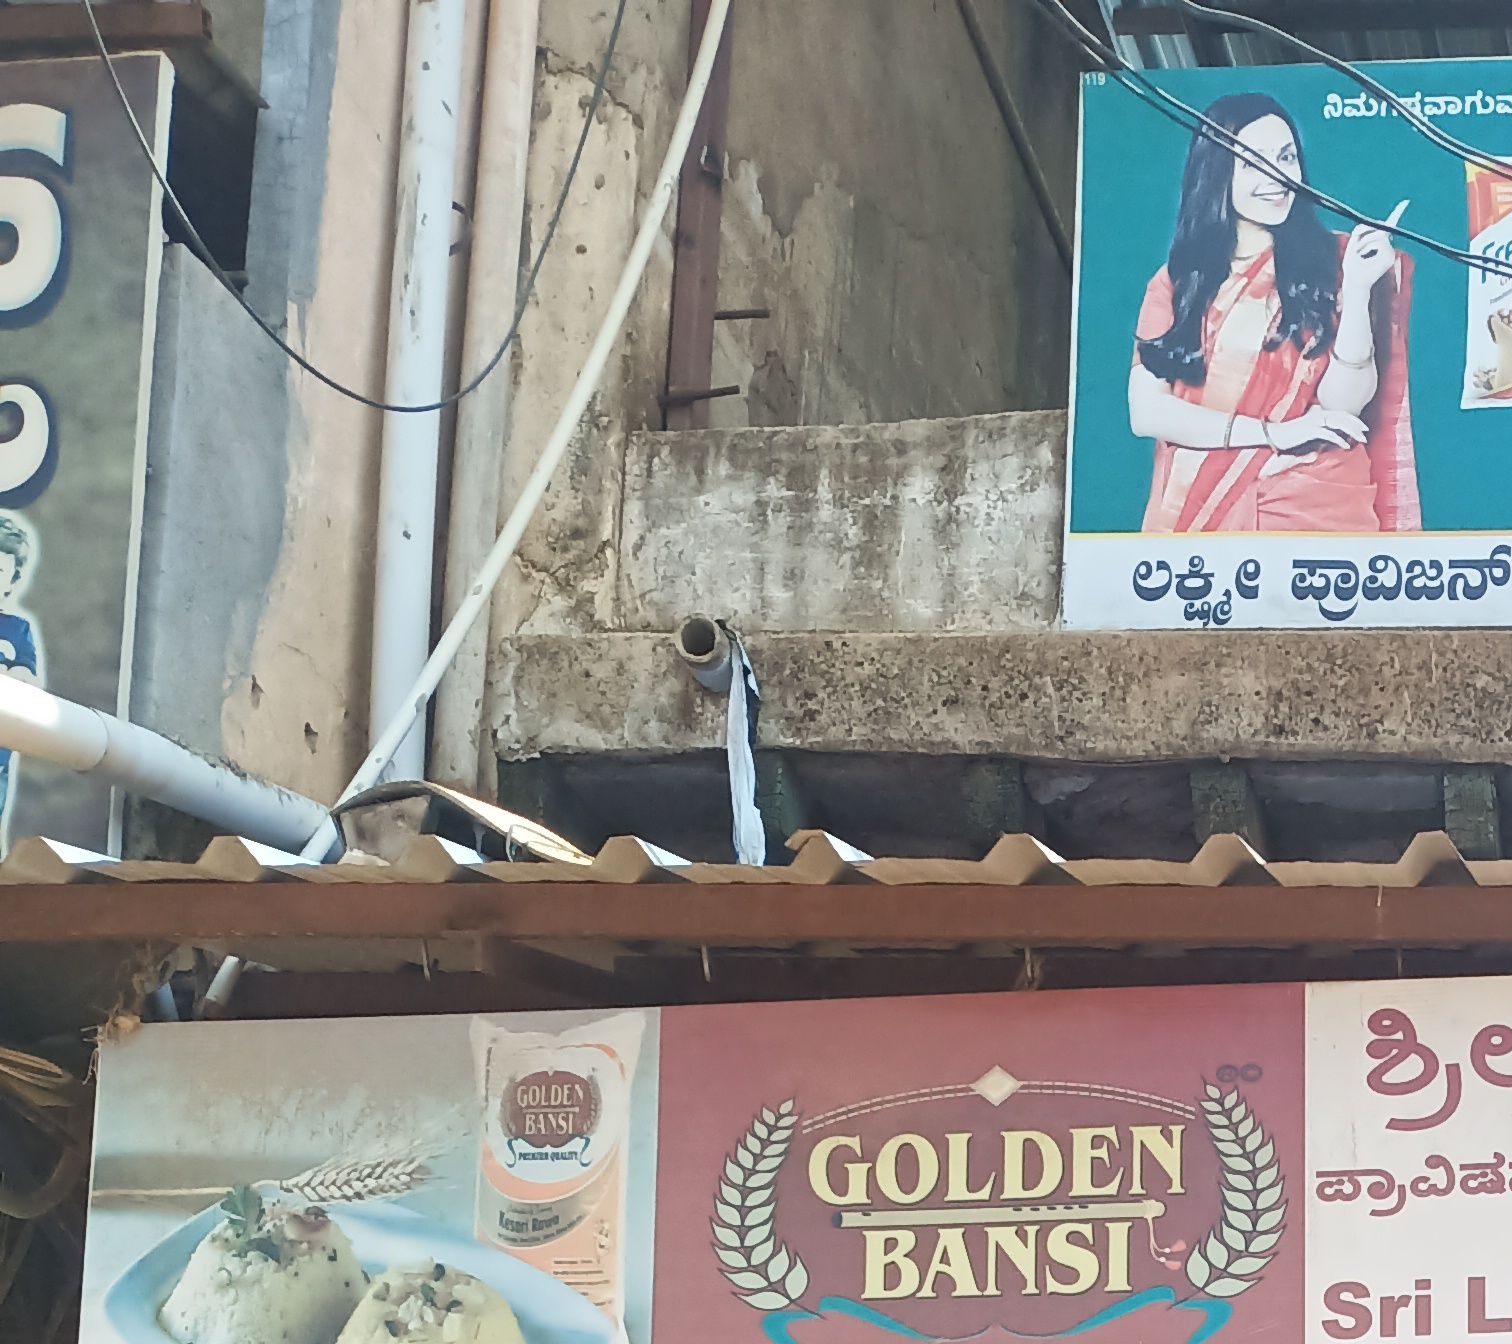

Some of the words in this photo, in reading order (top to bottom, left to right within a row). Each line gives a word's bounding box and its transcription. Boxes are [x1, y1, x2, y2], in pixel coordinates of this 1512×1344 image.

[1290, 544, 1512, 621] ಪ್ರಾವಿಜನ್
[517, 1083, 584, 1109] GOLDEN
[525, 1111, 575, 1135] BANSI
[807, 1123, 1188, 1206] GOLDEN
[861, 1220, 1135, 1300] BANSI
[1321, 1278, 1432, 1340] Sri
